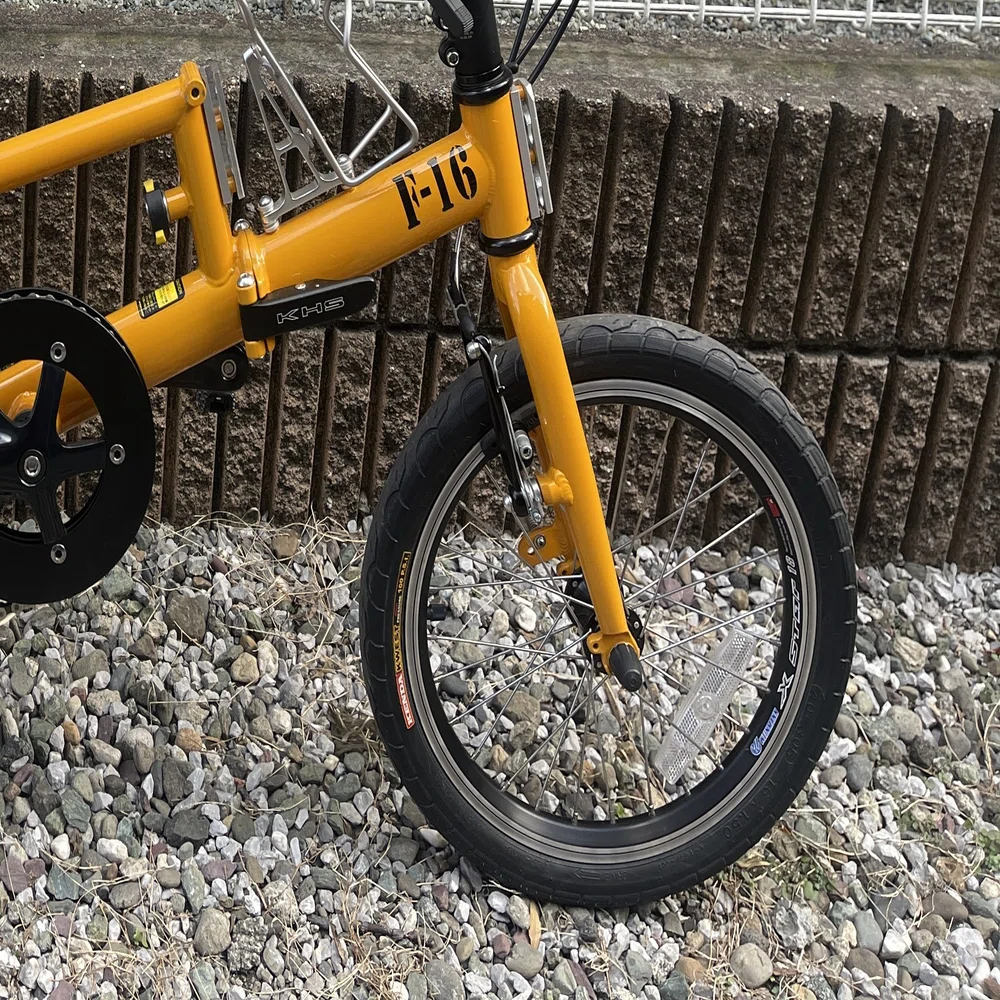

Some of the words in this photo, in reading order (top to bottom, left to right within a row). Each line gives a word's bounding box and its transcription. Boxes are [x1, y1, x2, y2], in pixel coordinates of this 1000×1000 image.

[392, 145, 478, 230] F-16
[276, 296, 345, 325] KHS
[785, 554, 798, 576] 18
[393, 625, 402, 672] KWEST
[398, 673, 413, 726] KENDA
[777, 671, 795, 711] X
